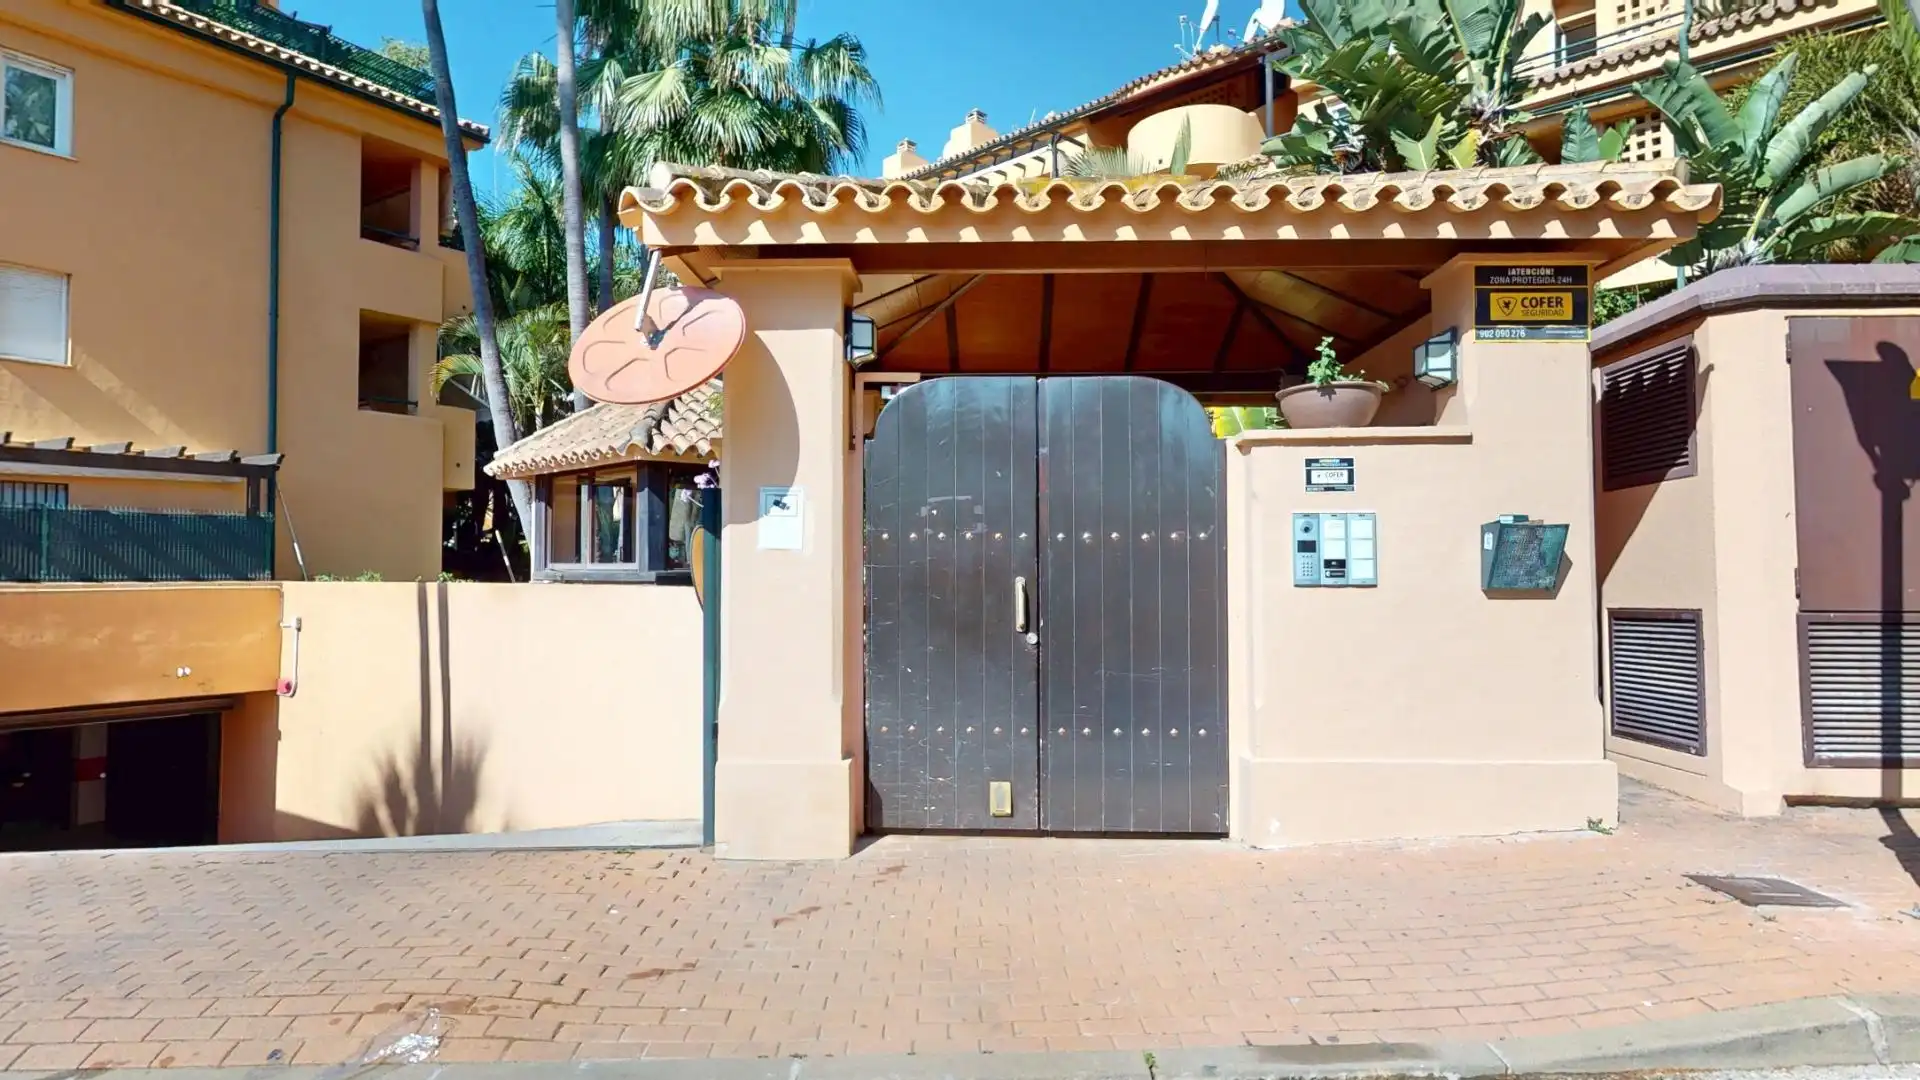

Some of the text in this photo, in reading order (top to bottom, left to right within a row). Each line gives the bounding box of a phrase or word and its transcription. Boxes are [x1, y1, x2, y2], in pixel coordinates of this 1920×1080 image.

[1489, 276, 1572, 284] ZONA PROTEGIDA 24H
[1521, 296, 1564, 308] COFER
[1521, 309, 1565, 317] SEGURIDAD
[1479, 329, 1494, 338] 902
